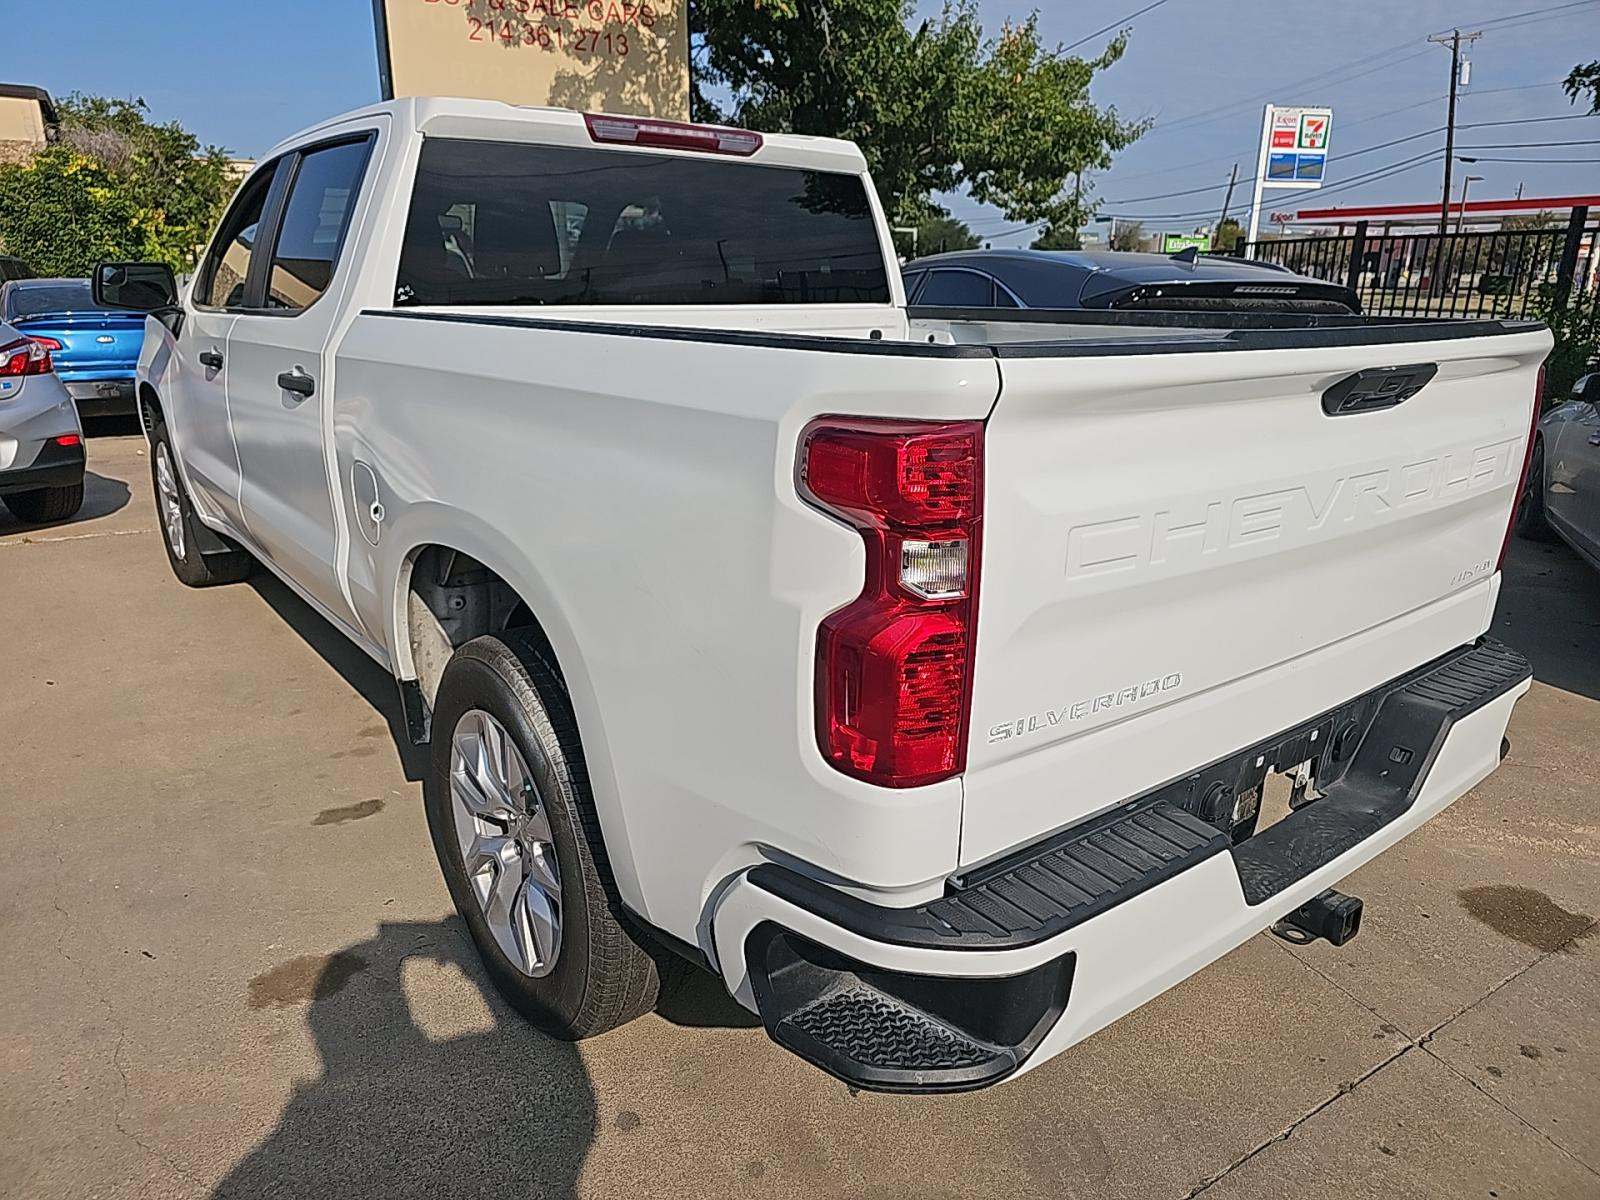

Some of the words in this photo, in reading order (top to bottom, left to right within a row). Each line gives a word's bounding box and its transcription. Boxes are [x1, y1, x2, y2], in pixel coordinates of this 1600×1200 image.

[468, 17, 513, 42] 214
[523, 23, 563, 49] 361
[574, 28, 629, 56] 2713
[588, 0, 655, 27] CARS
[1064, 435, 1524, 582] CHEVROLET
[988, 672, 1182, 744] SILVERADO
